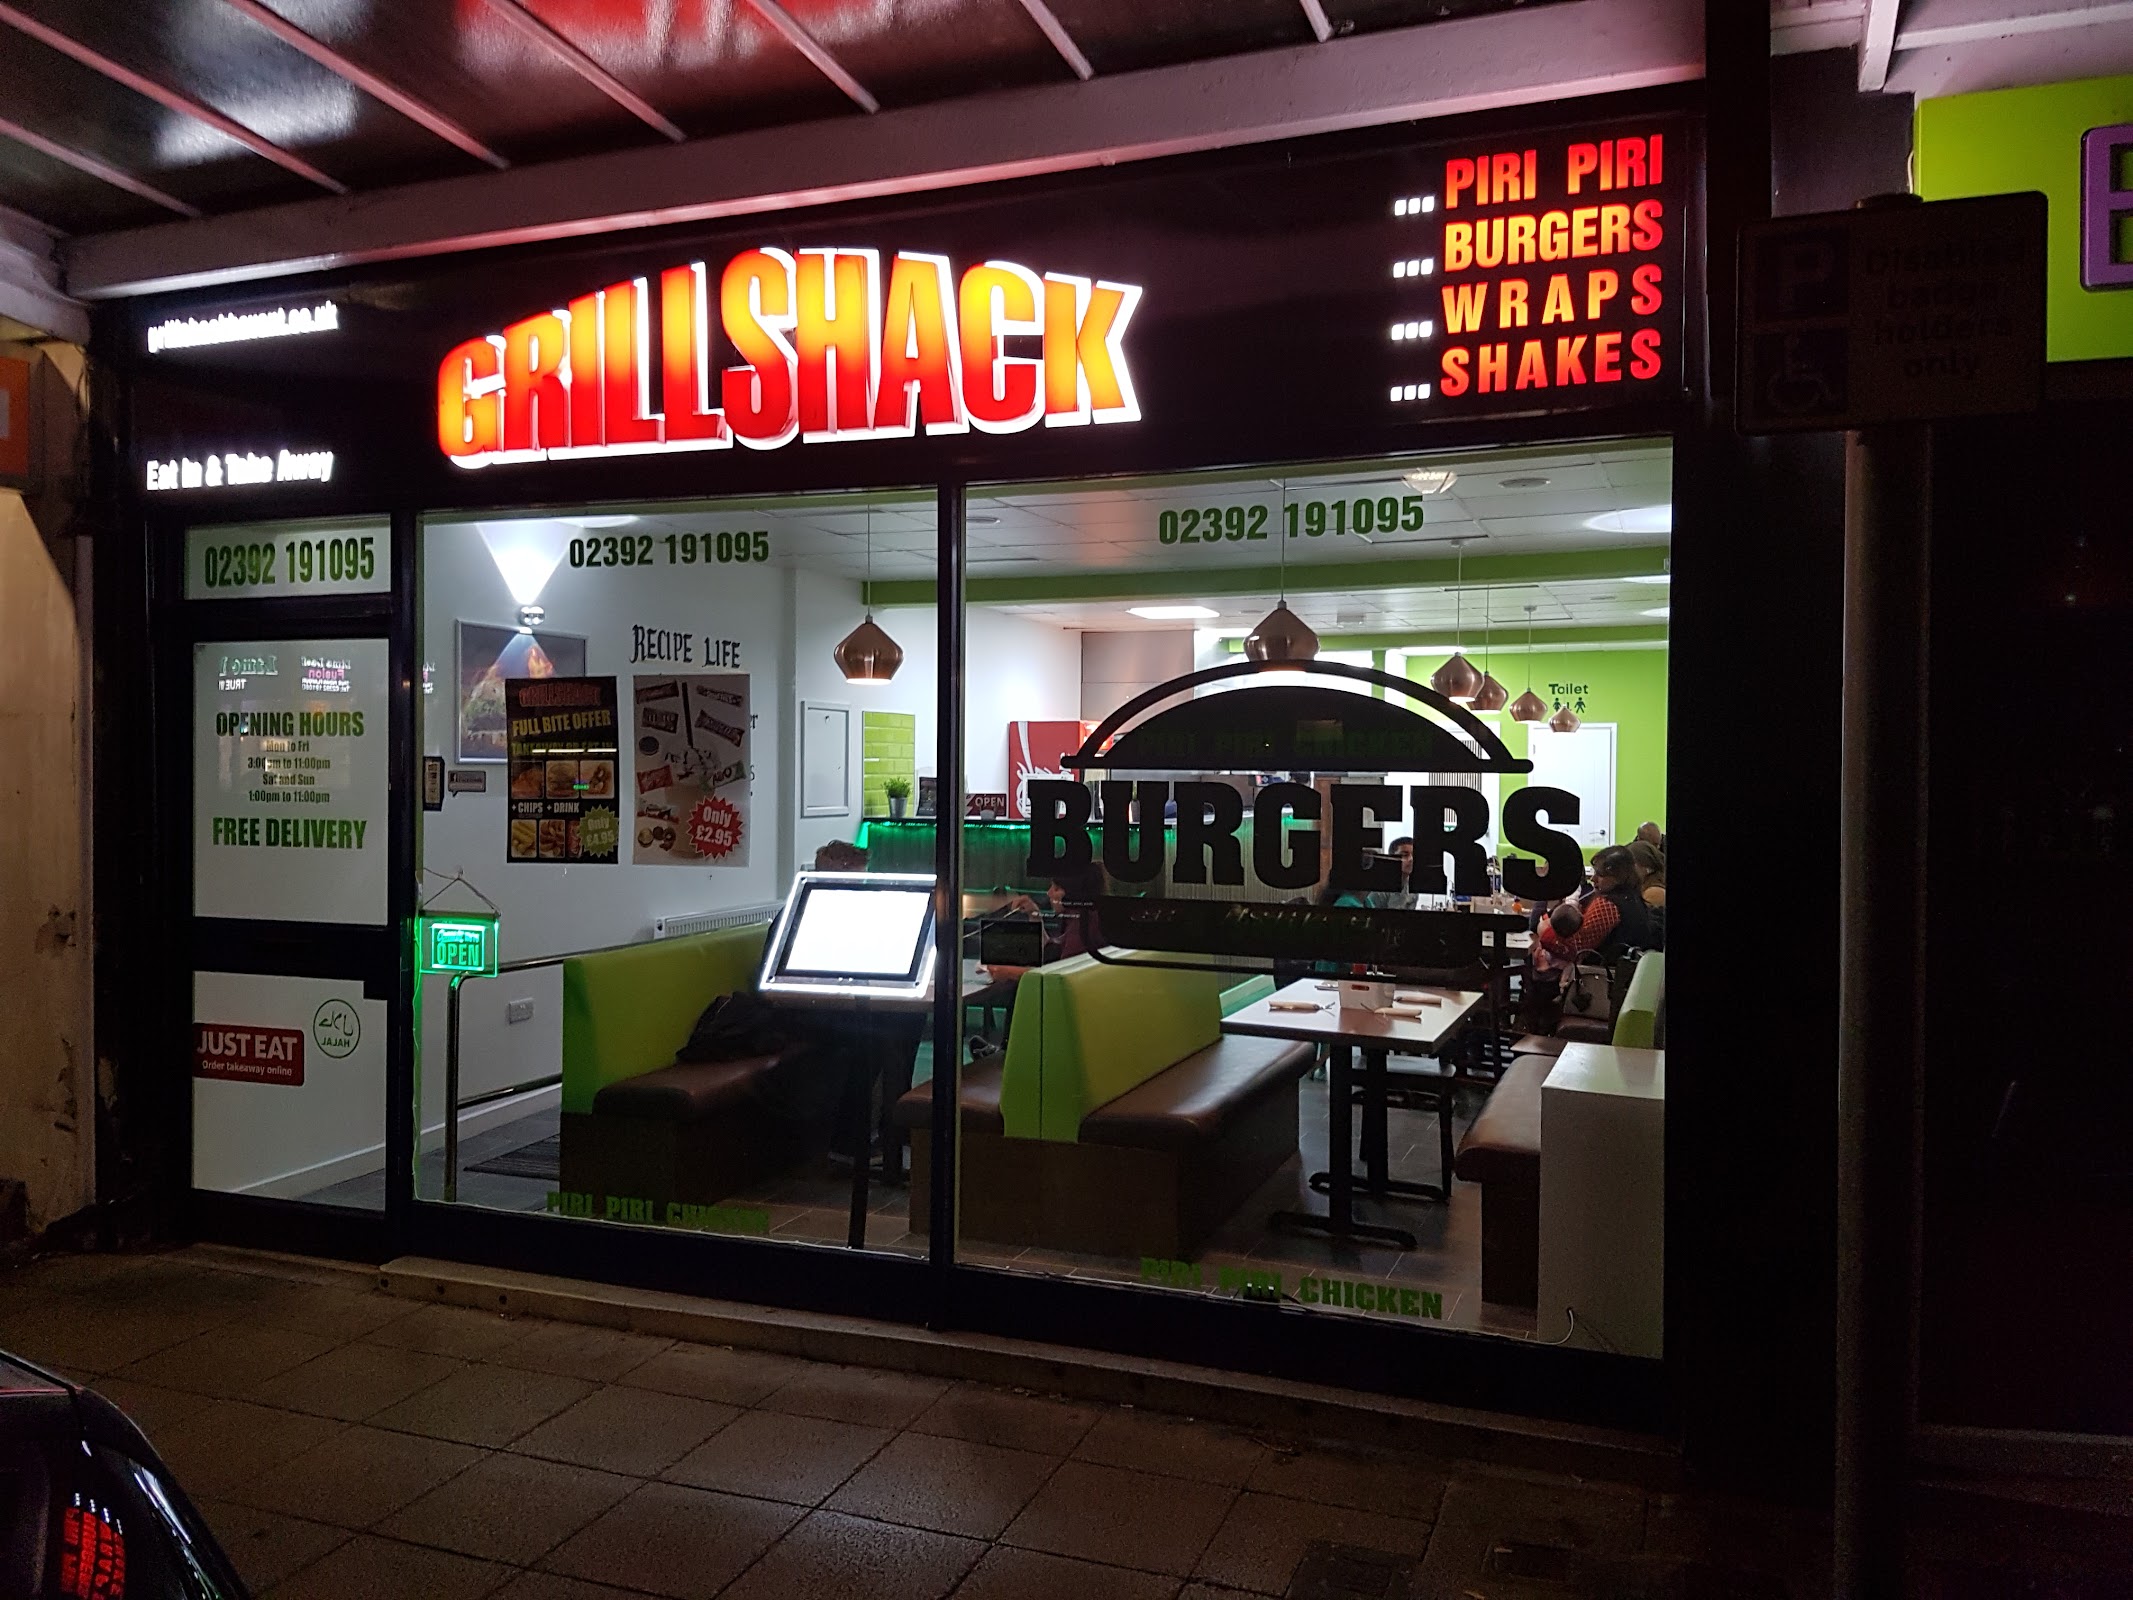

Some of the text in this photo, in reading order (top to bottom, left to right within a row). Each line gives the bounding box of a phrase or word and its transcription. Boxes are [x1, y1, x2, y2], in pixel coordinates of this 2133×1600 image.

[1445, 134, 1663, 209] PIRI PIRI
[1445, 199, 1663, 272] BURGERS
[1441, 263, 1663, 334] WRAPS
[438, 247, 1143, 469] GRILLSHACK
[1440, 328, 1661, 396] SHAKES
[147, 459, 178, 490] Eat
[206, 455, 223, 486] &
[225, 452, 273, 485] Take
[277, 449, 333, 482] Away
[1159, 495, 1424, 545] 02392 191095
[205, 537, 374, 588] 02392 191095
[569, 531, 769, 568] 02392 191095
[629, 624, 741, 669] RECIPE LIFE
[1549, 683, 1588, 695] Toilet
[216, 712, 364, 737] OPENING HOURS
[513, 709, 611, 737] FULL BITE OFFER
[298, 740, 309, 752] Fri
[282, 757, 292, 769] to
[294, 757, 330, 770] 11:00pm
[263, 774, 314, 785] Sat and Sun
[249, 790, 330, 804] 1:00pm to 11:00pm
[518, 802, 543, 814] CHIPS
[554, 802, 579, 814] DRINK
[975, 797, 1004, 807] OPEN
[588, 818, 610, 829] Only
[703, 807, 732, 828] Only
[212, 817, 367, 849] FREE DELIVERY
[695, 825, 733, 847] £2.95
[1027, 780, 1583, 900] BURGERS
[437, 942, 479, 966] OPEN
[197, 1031, 297, 1061] JUST EAT
[202, 1060, 292, 1076] Order takeaway online
[1300, 1277, 1442, 1320] CHICKEN
